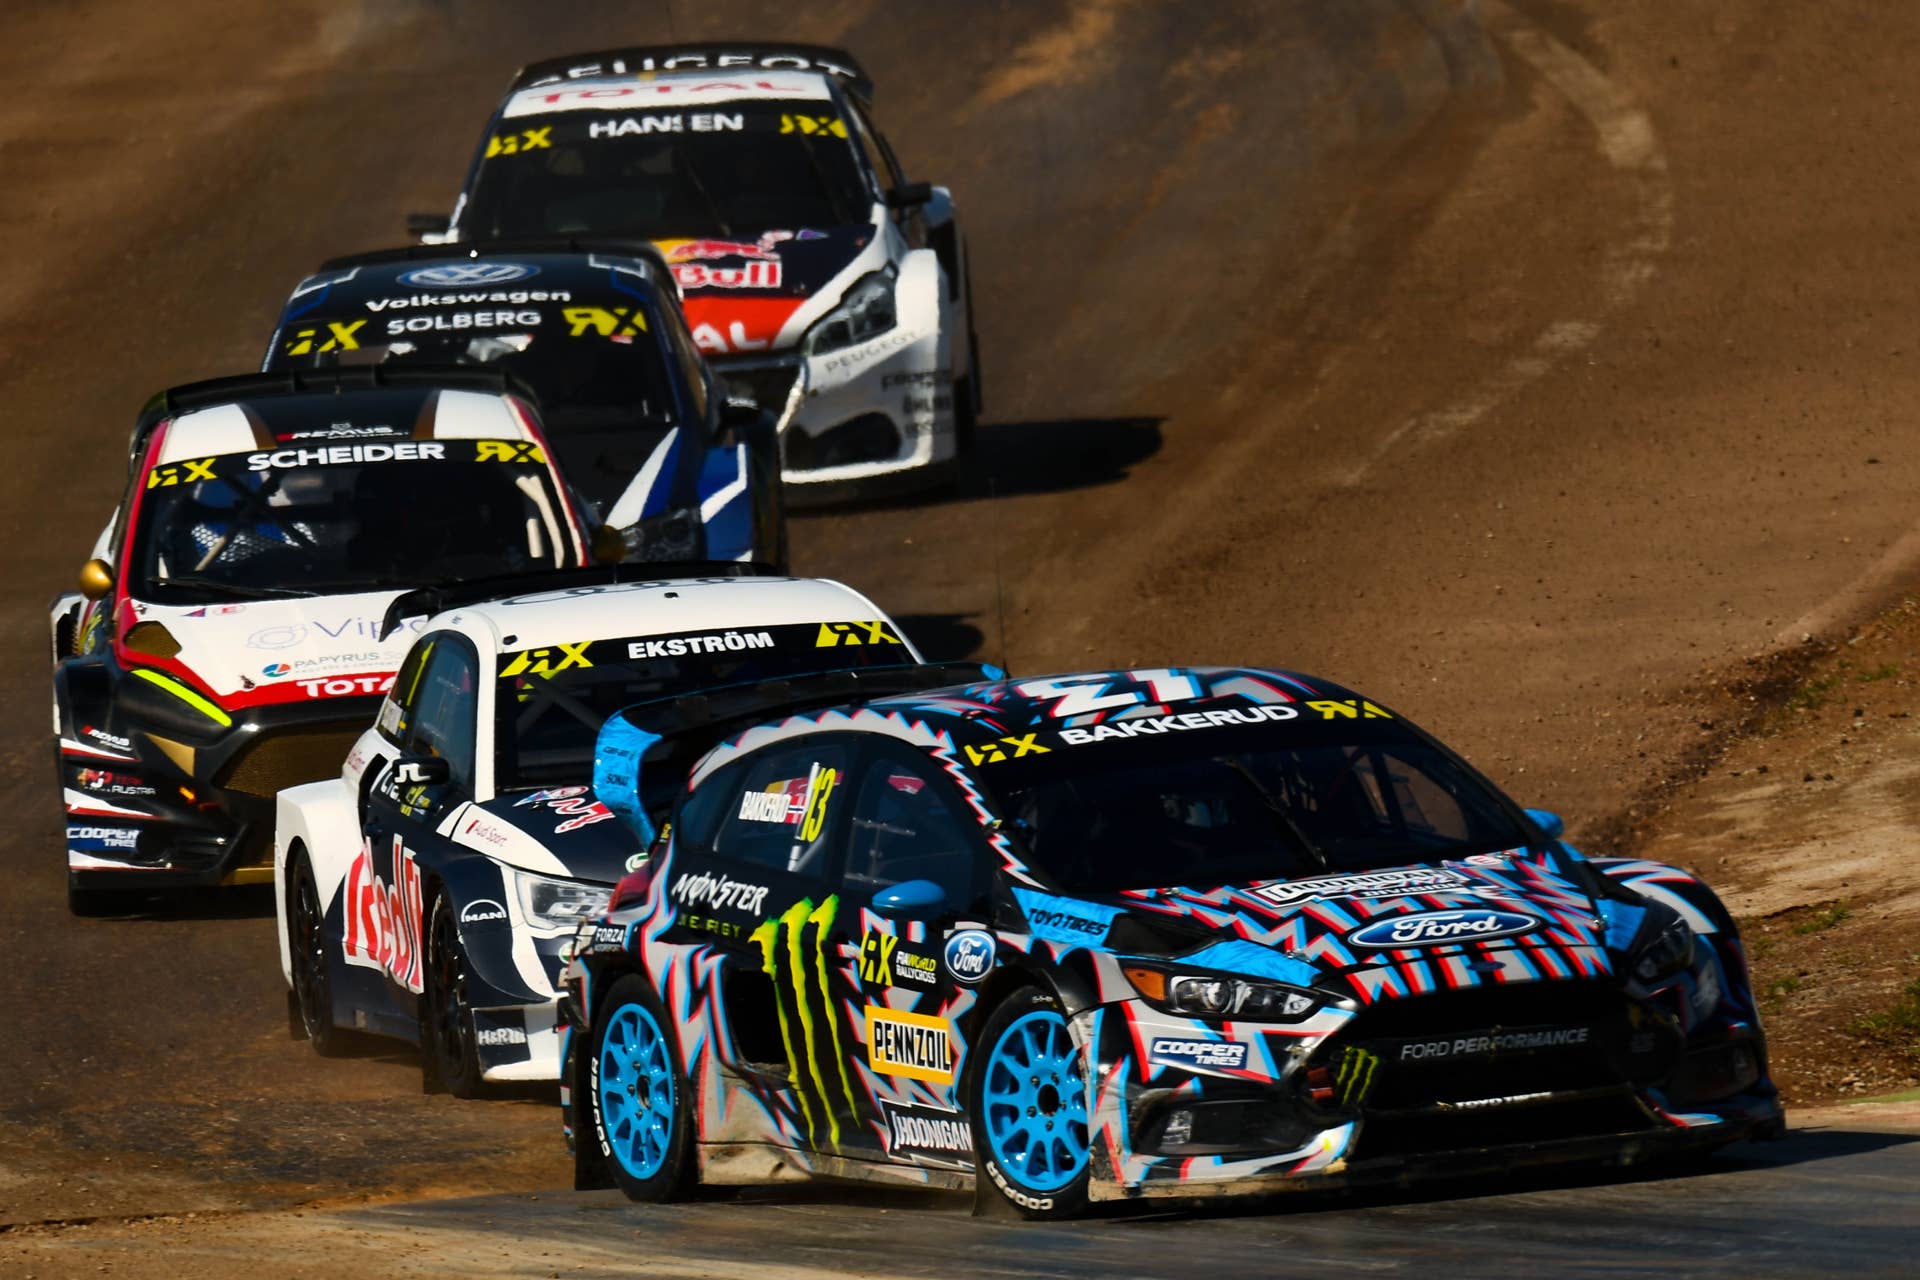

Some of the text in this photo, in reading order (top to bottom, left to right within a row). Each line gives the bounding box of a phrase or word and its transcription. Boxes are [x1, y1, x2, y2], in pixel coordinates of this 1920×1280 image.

[529, 80, 806, 104] TOTAL
[365, 290, 571, 312] Volkswagen
[386, 311, 542, 336] SOLBERG
[824, 330, 919, 373] PEUGEOT
[247, 441, 446, 472] SCHEIDER
[627, 631, 776, 660] EKSTRÖM
[294, 651, 380, 667] PAPYRUS
[1057, 704, 1300, 746] BAKKERUD
[738, 790, 793, 824] BAKKERUD
[66, 827, 140, 840] COOPER
[102, 838, 137, 848] TIRES
[464, 911, 506, 923] MAN
[1064, 915, 1110, 936] TIRES
[1390, 912, 1504, 942] Ford
[596, 928, 624, 943] FORZA
[953, 937, 984, 974] Ford
[896, 964, 937, 984] RALLYCROSS
[873, 1020, 951, 1073] PENNZOIL
[1153, 1040, 1246, 1057] COOPER
[1400, 1027, 1590, 1061] FORD PERFORMANCE
[1195, 1055, 1243, 1067] TIRES
[590, 1056, 611, 1157] COOPER
[985, 1160, 1053, 1211] COOPER
